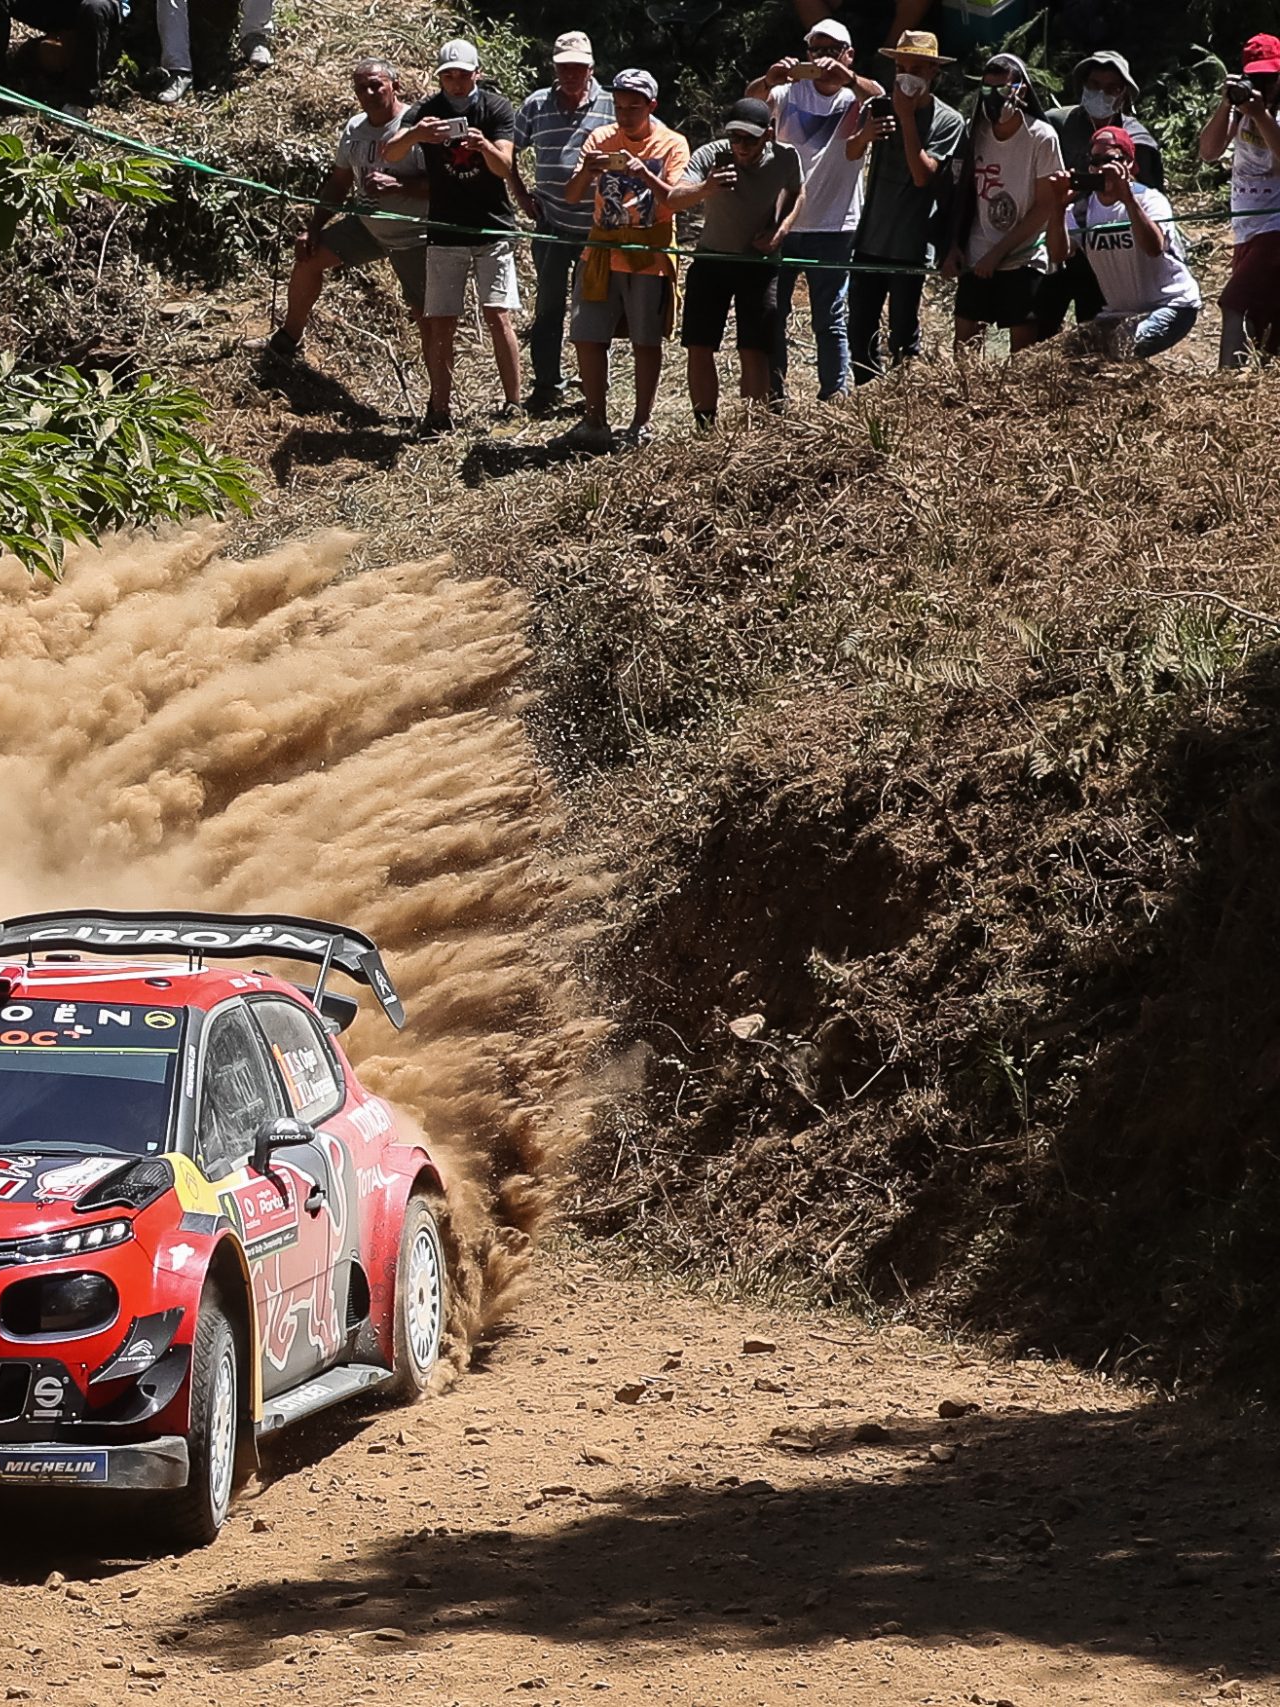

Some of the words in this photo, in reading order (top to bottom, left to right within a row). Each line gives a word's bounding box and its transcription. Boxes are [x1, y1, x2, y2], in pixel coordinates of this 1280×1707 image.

[1084, 232, 1134, 250] VANS
[29, 926, 328, 950] CITROËN
[356, 1163, 401, 1199] TOTAL
[4, 1460, 97, 1473] MICHELIN
